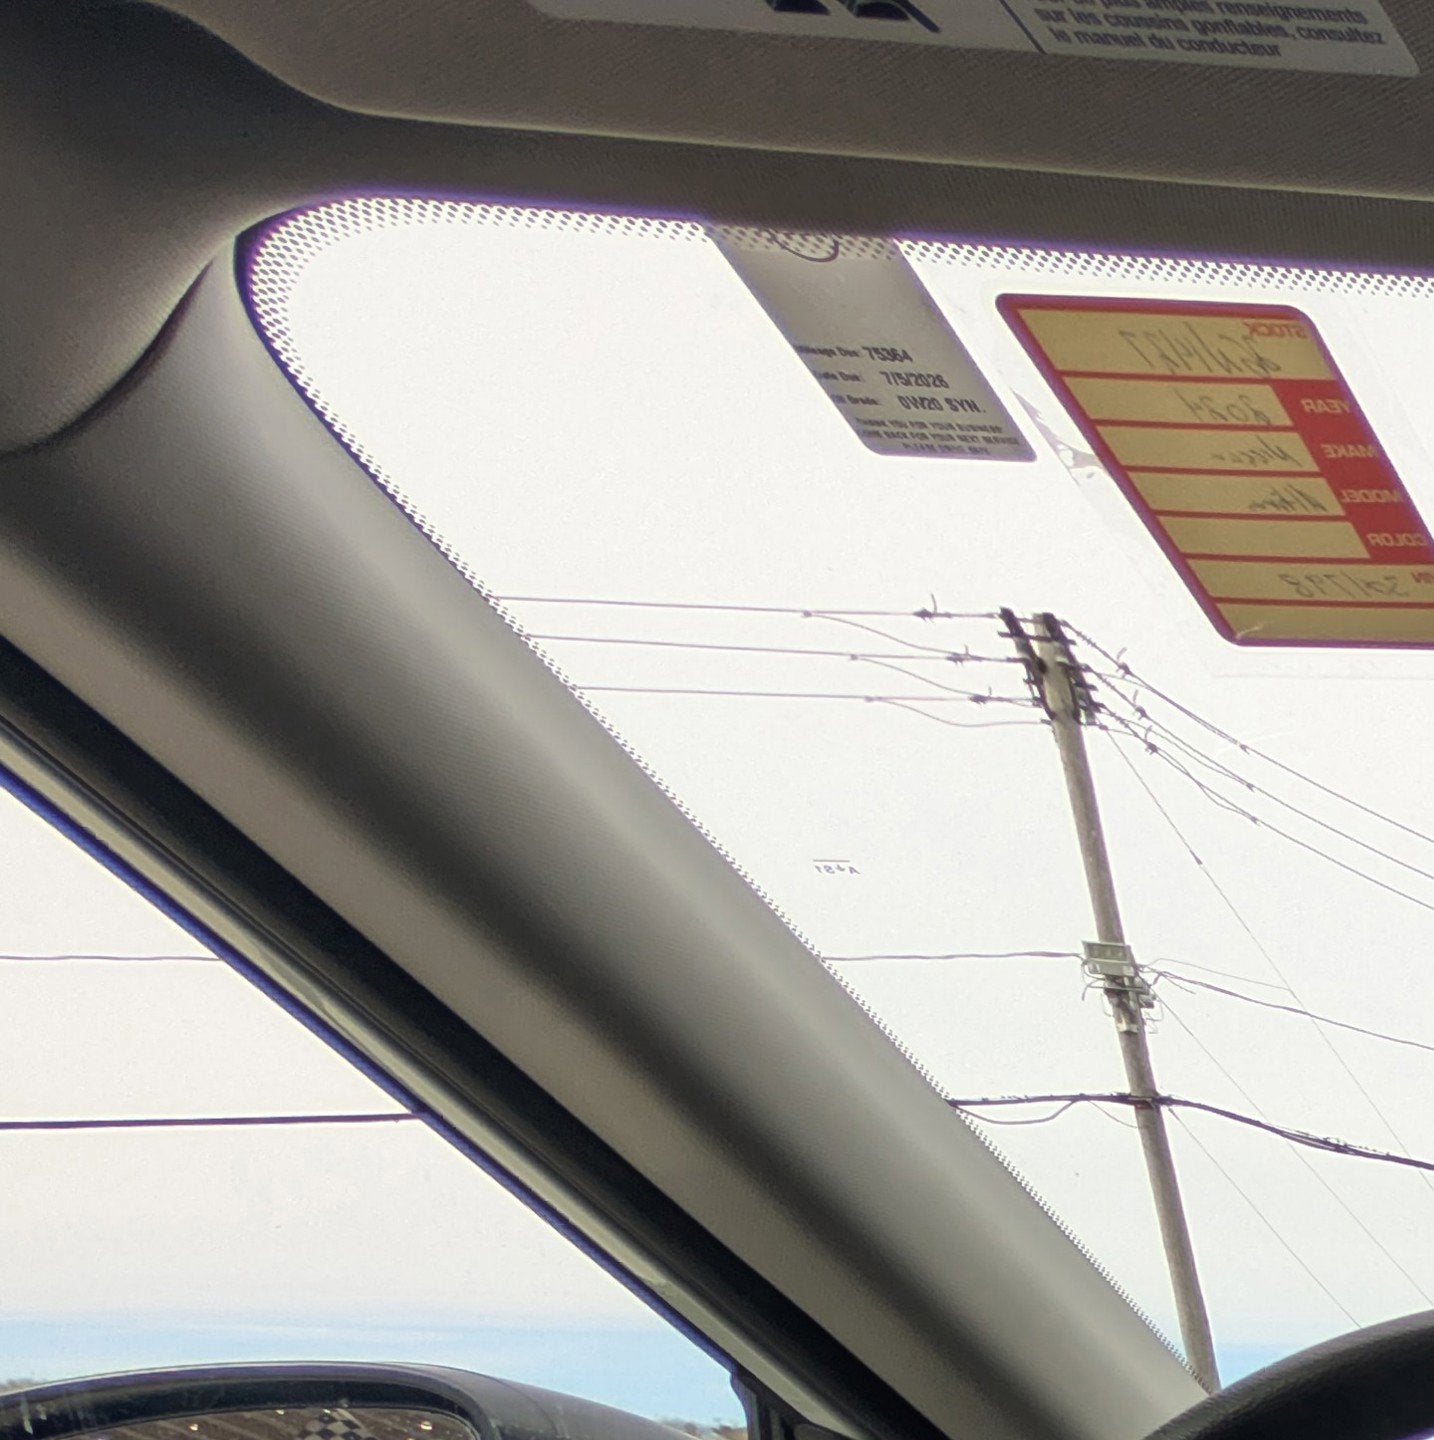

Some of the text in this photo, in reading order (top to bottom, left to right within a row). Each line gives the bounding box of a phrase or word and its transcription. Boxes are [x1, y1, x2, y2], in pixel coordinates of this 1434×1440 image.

[1033, 8, 1067, 24] sur
[1068, 8, 1103, 26] les
[1103, 13, 1189, 32] coussins
[1296, 25, 1387, 45] consultez
[1216, 2, 1369, 24] renseignements
[1047, 26, 1285, 58] le manuel du conducteur
[862, 345, 913, 363] 75364
